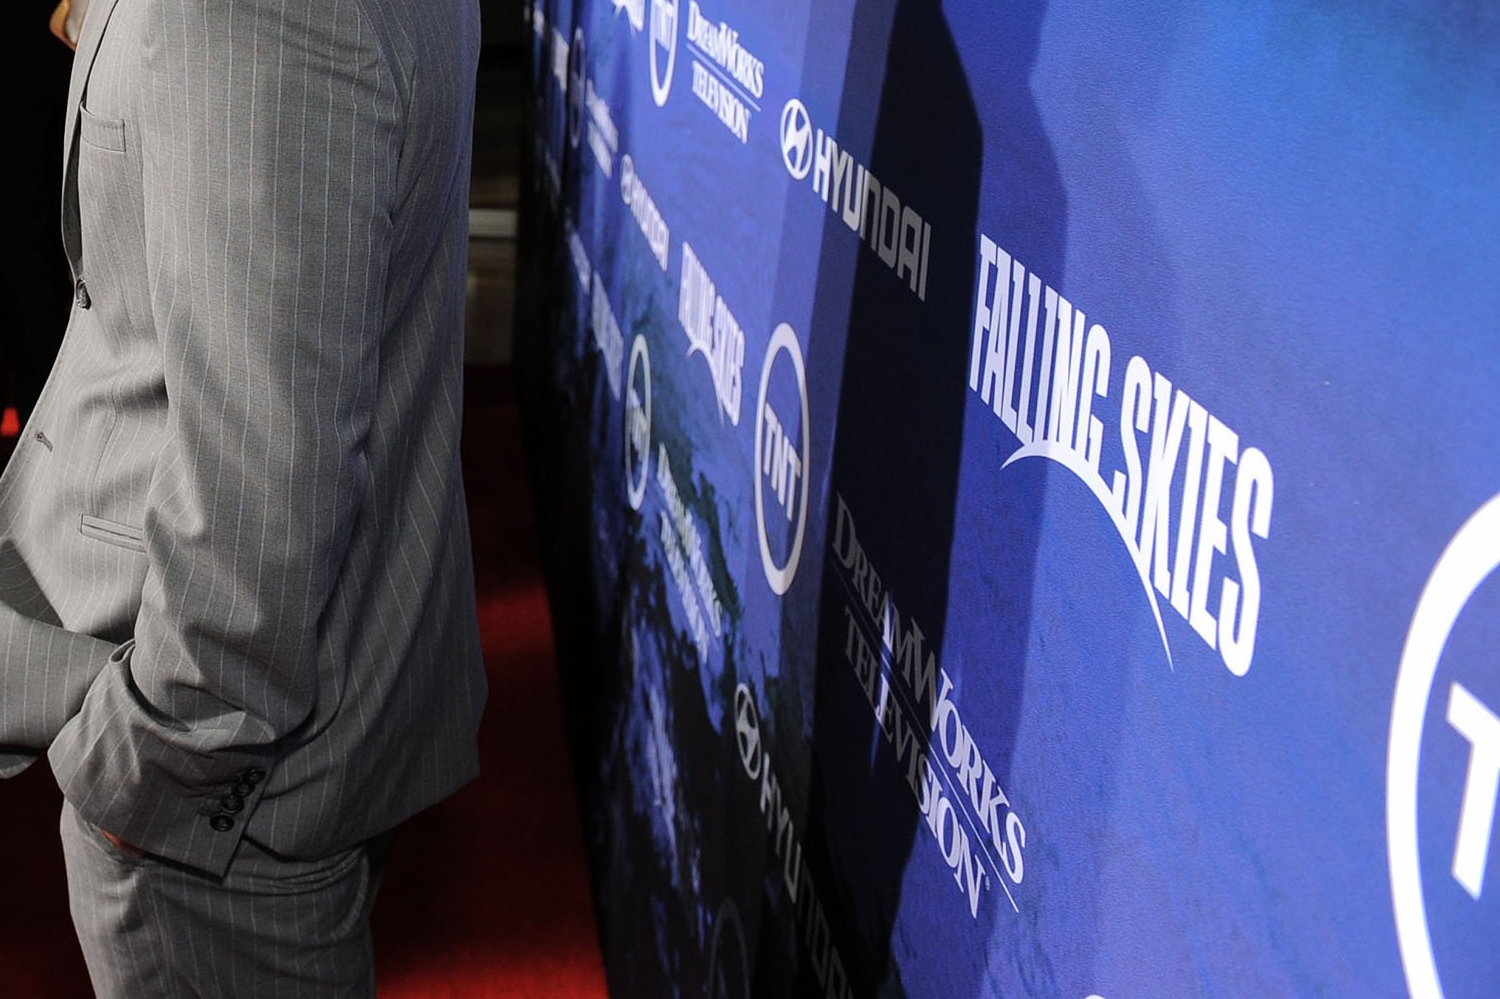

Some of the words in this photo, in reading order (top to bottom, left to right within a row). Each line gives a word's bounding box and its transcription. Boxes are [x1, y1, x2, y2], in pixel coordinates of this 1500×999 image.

[812, 129, 931, 302] HYUNDAI
[763, 402, 801, 521] TNT
[969, 233, 1112, 477] FALLING
[1112, 356, 1274, 678] SKIES
